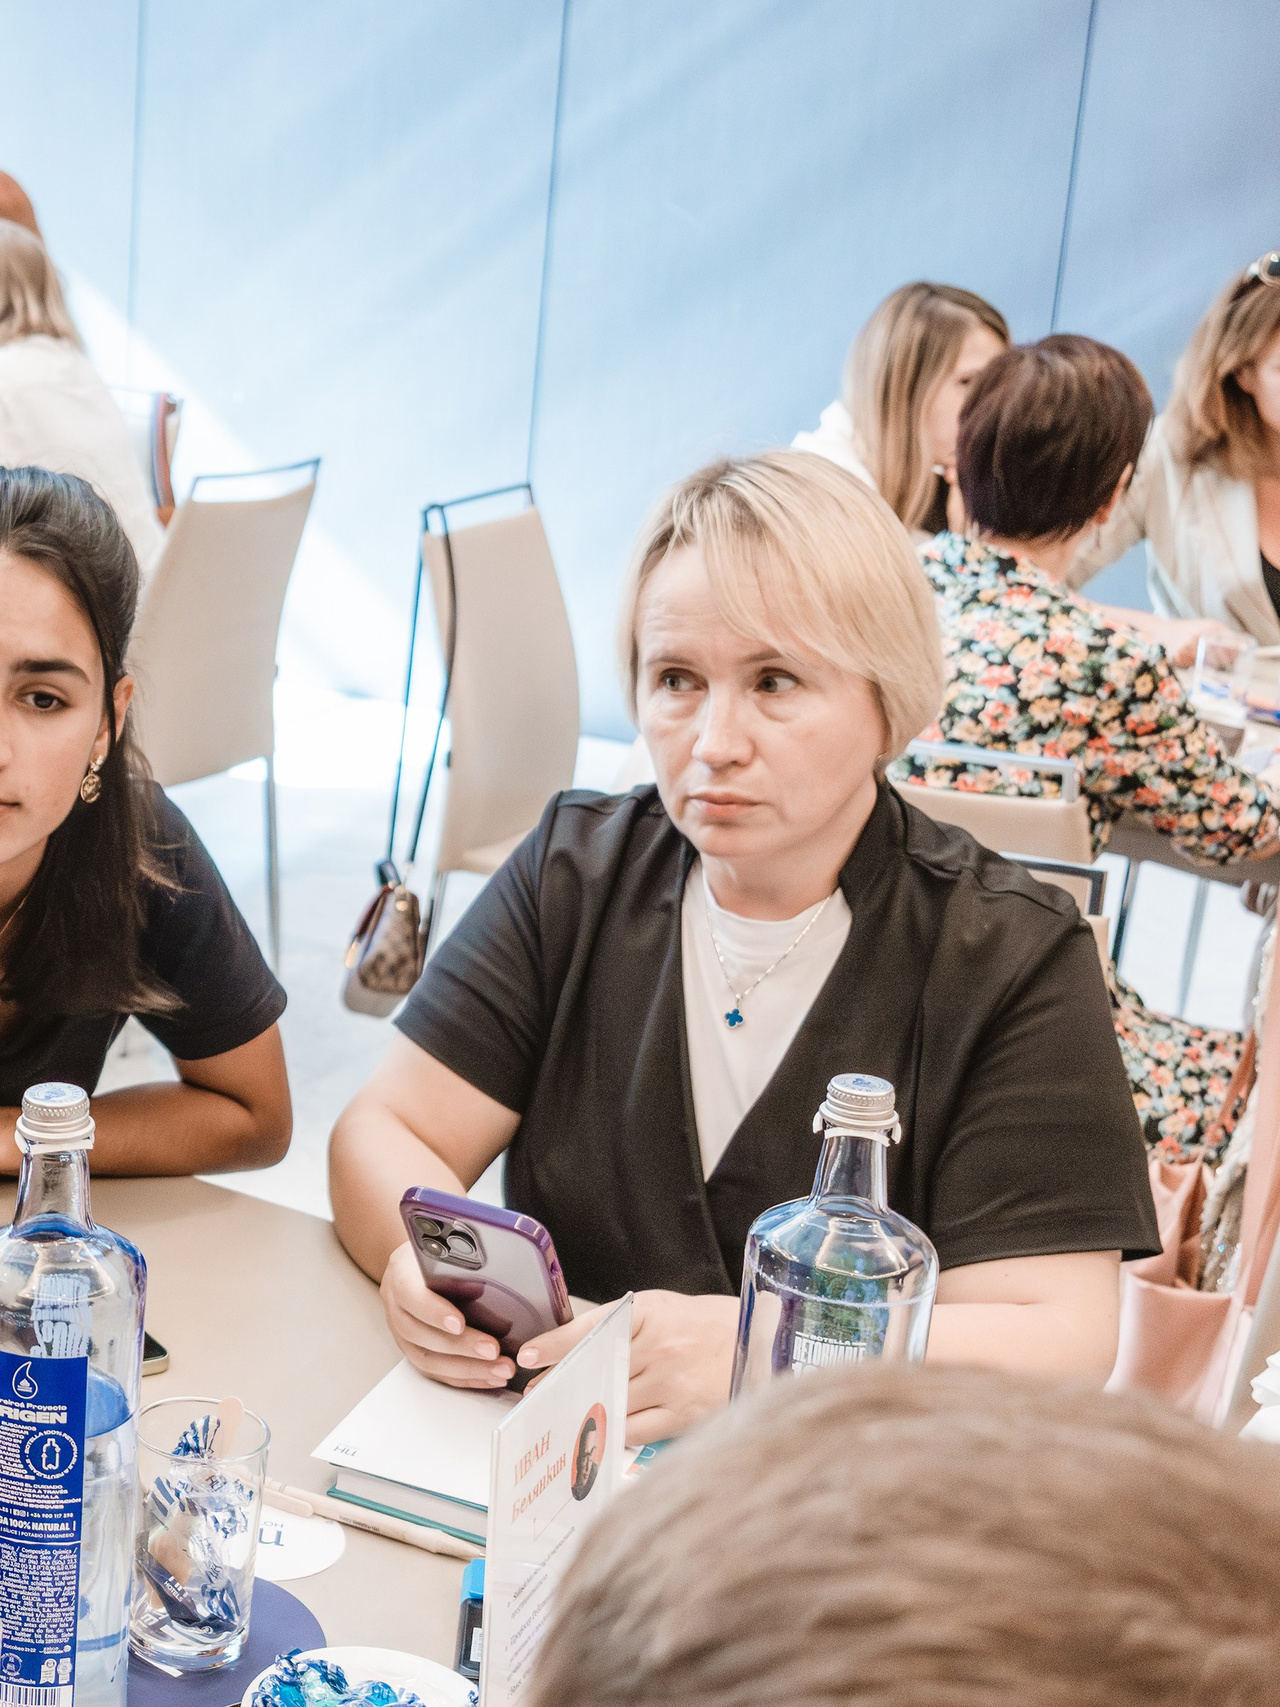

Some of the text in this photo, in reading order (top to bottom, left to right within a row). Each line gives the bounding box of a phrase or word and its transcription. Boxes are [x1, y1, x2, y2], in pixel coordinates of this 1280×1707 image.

[809, 1334, 851, 1346] BOTELLA
[26, 1403, 68, 1412] Proyecto
[0, 1425, 29, 1435] GENERAR
[1, 1421, 37, 1431] BUSCAMOS
[514, 1429, 551, 1487] ИВАН
[1, 1464, 28, 1474] VIDRIO
[511, 1453, 567, 1525] Белянкин
[9, 1516, 31, 1530] 100%
[31, 1521, 71, 1532] NATURAL
[21, 1531, 43, 1539] POTASIO
[163, 1580, 183, 1602] HOTELS
